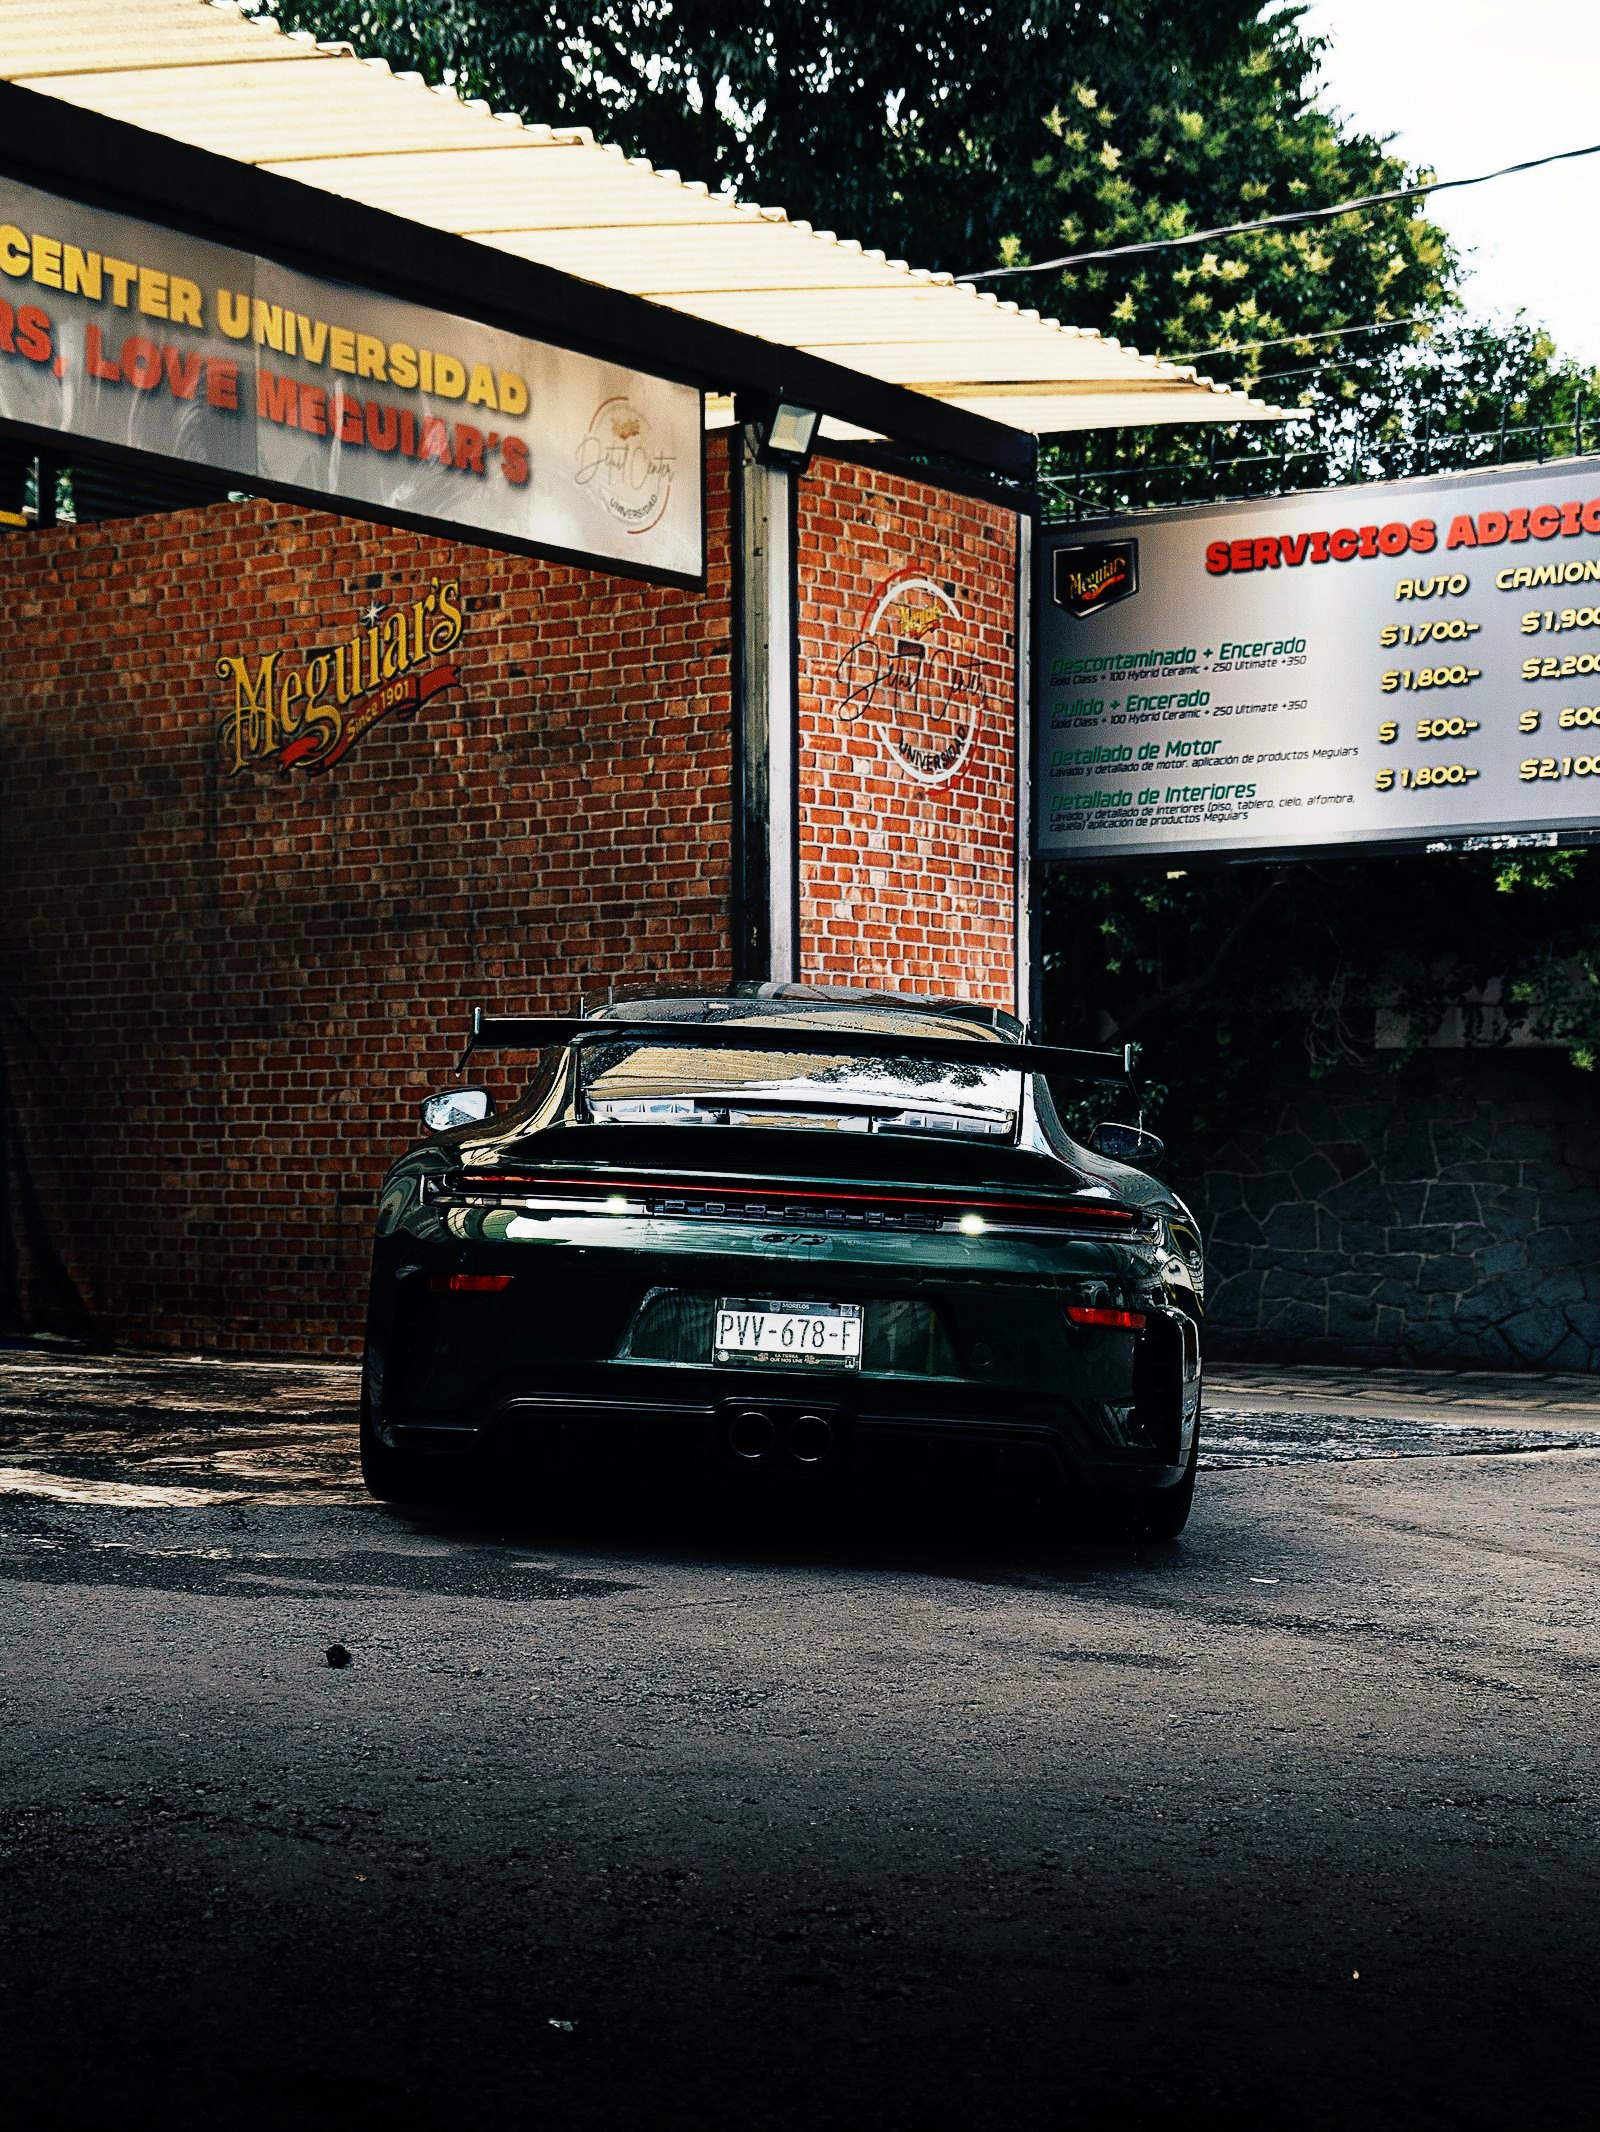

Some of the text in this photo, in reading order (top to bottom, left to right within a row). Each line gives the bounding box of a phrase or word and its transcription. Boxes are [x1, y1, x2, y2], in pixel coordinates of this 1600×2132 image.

[0, 224, 529, 416] CENTER UNIVERSIDAD
[86, 322, 237, 410] LOVE
[257, 369, 529, 485] MEGUIAR'S
[1205, 519, 1436, 573] SERVICIOS
[1395, 574, 1468, 600] AUTO
[1051, 637, 1306, 673] Descontaminado + Encerado
[215, 577, 463, 778] Meguiar's
[1128, 669, 1159, 681] Hybrid
[1162, 665, 1200, 677] Ceramic
[1212, 662, 1232, 672] 250
[1235, 659, 1277, 670] Ultimate
[380, 680, 409, 708] 1901
[1051, 690, 1210, 718] Pulido + Encerado
[1128, 712, 1160, 724] Hybrid
[1162, 709, 1201, 720] Ceramic
[1213, 706, 1232, 716] 250
[1235, 703, 1278, 714] Ultimate
[1050, 739, 1222, 767] Detallado de Motor
[1086, 767, 1092, 776] y
[1095, 764, 1139, 775] detallado
[1141, 762, 1153, 771] de
[1191, 755, 1239, 768] aplicación
[1242, 754, 1254, 763] de
[1257, 750, 1308, 764] productos
[1050, 783, 1256, 811] Detallado de Interiores
[1086, 812, 1092, 821] y
[1095, 808, 1139, 820] detallado
[1141, 806, 1153, 816] de
[1156, 803, 1204, 815] interiores
[1136, 818, 1149, 826] de
[1150, 814, 1200, 827] productos
[782, 1302, 809, 1310] MORELOS
[720, 1314, 856, 1351] PVV-678-F
